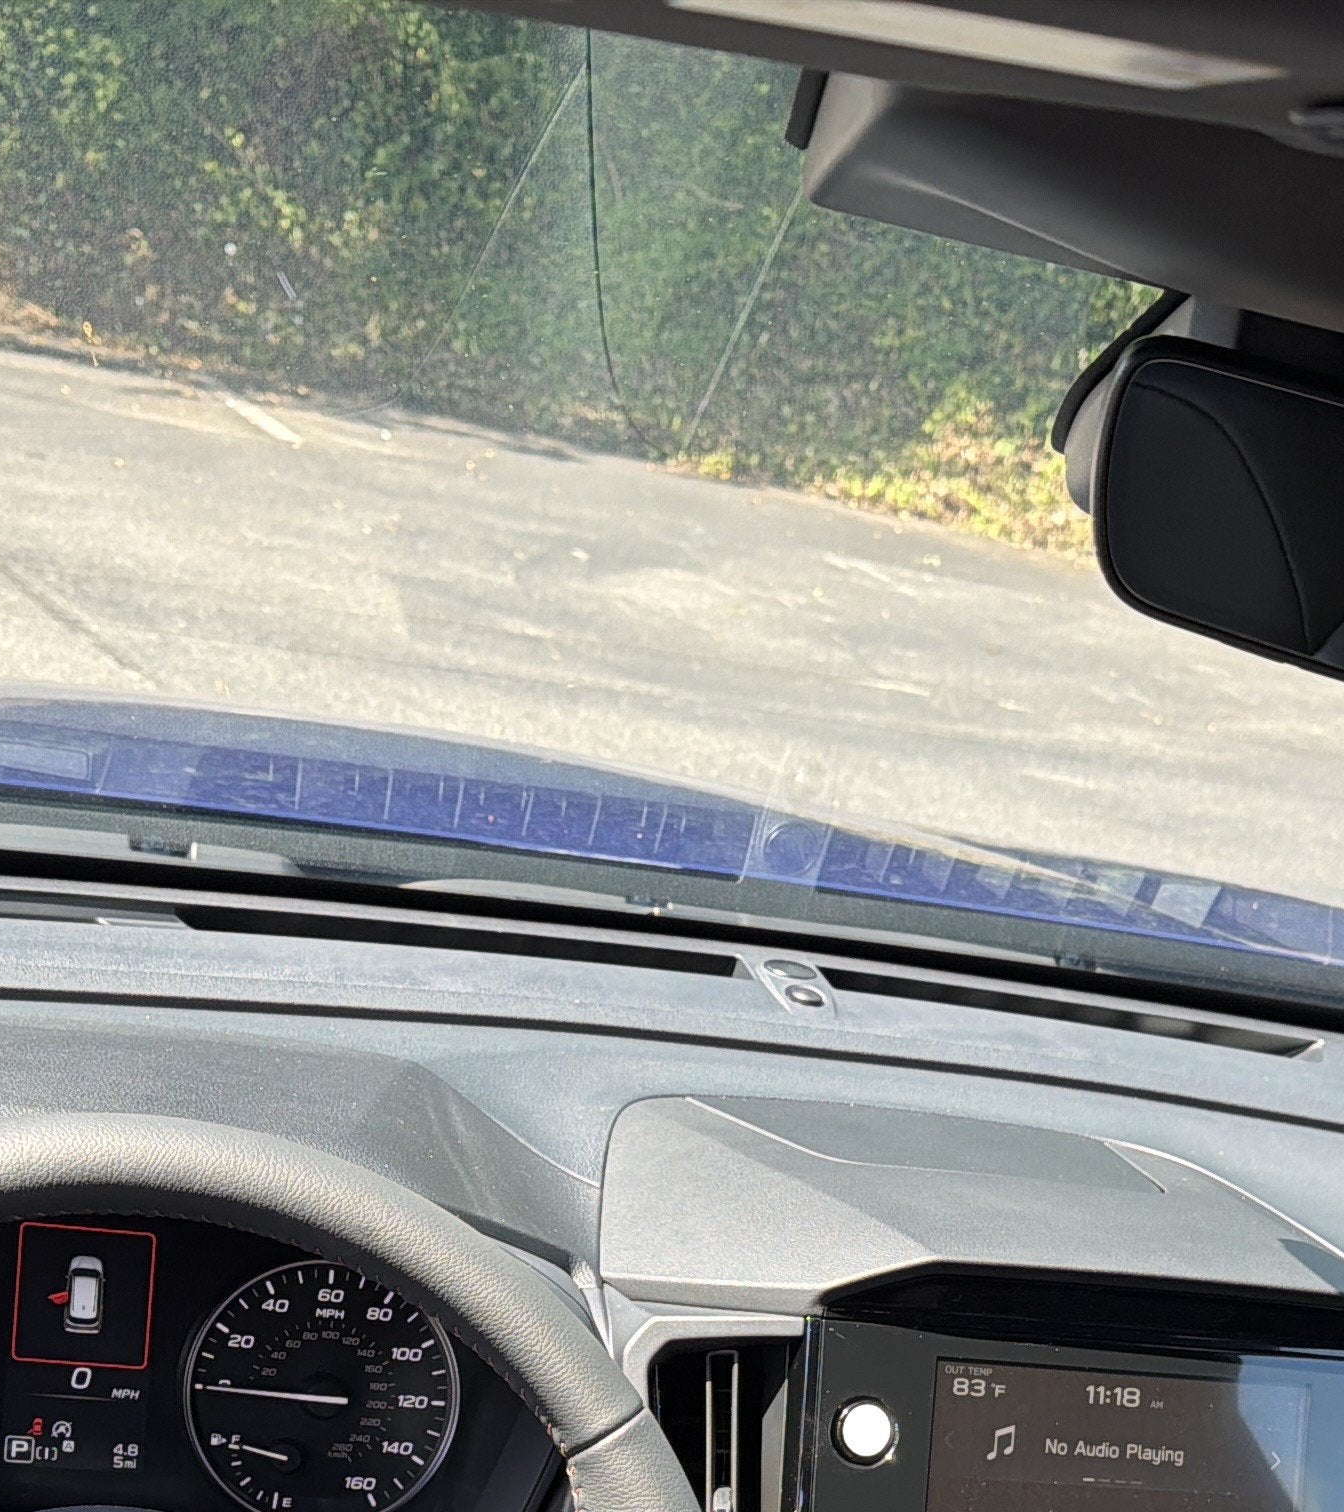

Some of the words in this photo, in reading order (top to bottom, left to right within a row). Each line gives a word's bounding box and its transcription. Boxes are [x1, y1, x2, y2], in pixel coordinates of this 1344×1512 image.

[317, 1288, 344, 1303] 60
[261, 1299, 289, 1313] 40
[315, 1307, 345, 1320] MPH
[366, 1307, 393, 1322] 80
[302, 1331, 318, 1341] 80
[321, 1330, 340, 1340] 100
[227, 1335, 255, 1349] 20
[285, 1339, 301, 1349] 60
[342, 1337, 360, 1346] 120
[270, 1351, 287, 1361] 40
[357, 1348, 376, 1358] 140
[391, 1347, 422, 1362] 100
[261, 1367, 277, 1377] 20
[364, 1364, 383, 1374] 160
[945, 1364, 964, 1375] OUT
[967, 1366, 993, 1377] TEMP
[70, 1367, 92, 1390] 0
[369, 1382, 388, 1391] 180
[953, 1377, 986, 1397] 83
[111, 1388, 140, 1400] MPH
[1086, 1384, 1141, 1408] 11:18
[1150, 1400, 1164, 1410] AM
[365, 1400, 387, 1409] 200
[397, 1394, 429, 1409] 120
[360, 1417, 381, 1427] 220
[231, 1434, 241, 1446] F
[349, 1433, 371, 1443] 240
[10, 1440, 29, 1458] P
[113, 1443, 139, 1457] 4.8
[331, 1442, 353, 1452] 260
[382, 1441, 413, 1456] 140
[1045, 1438, 1068, 1456] No
[1074, 1440, 1119, 1459] Audio
[1126, 1443, 1184, 1466] Playing
[344, 1476, 376, 1491] 160
[282, 1497, 293, 1508] E
